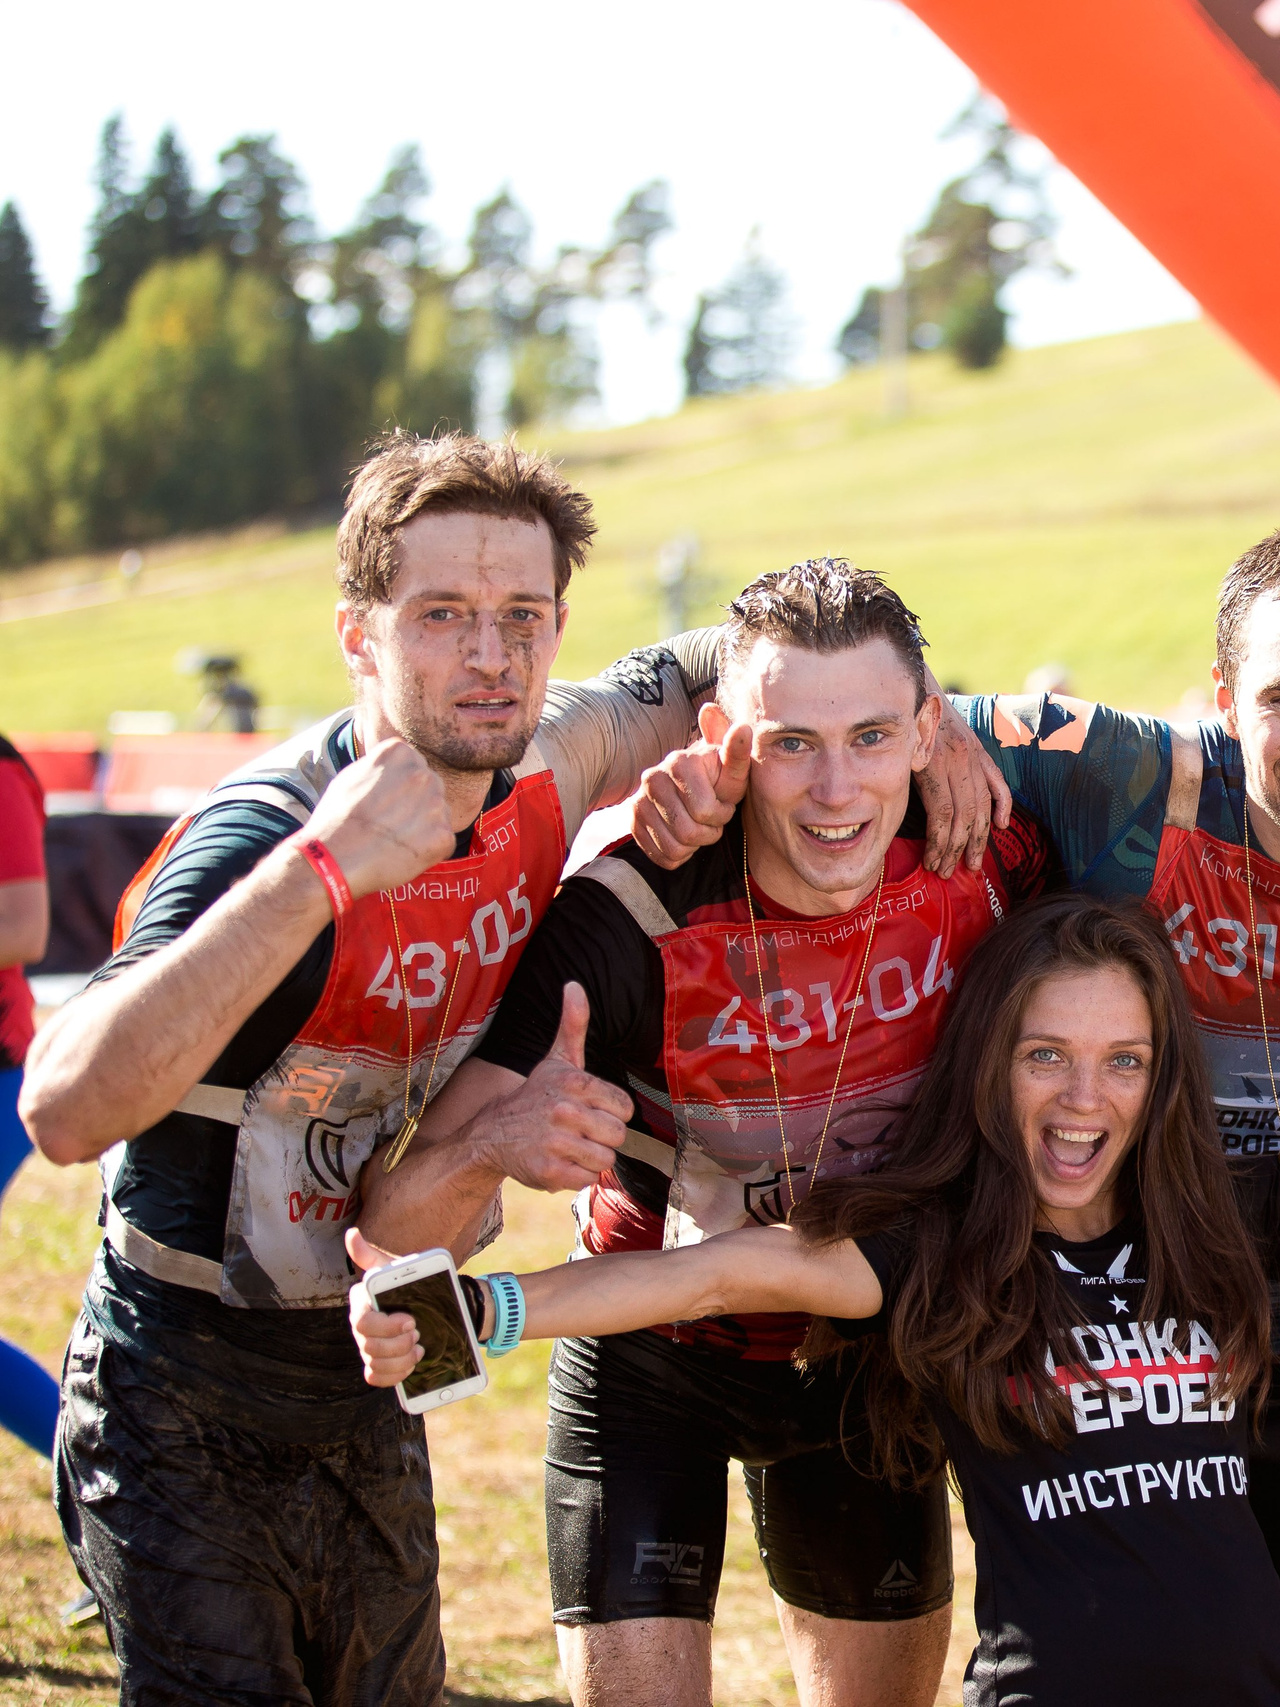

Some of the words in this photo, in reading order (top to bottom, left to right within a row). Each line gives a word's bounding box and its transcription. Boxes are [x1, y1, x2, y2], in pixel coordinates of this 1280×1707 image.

[725, 909, 877, 955] Командный
[708, 935, 955, 1054] 431-04
[1080, 1277, 1106, 1285] ЛИГА
[1108, 1277, 1146, 1285] ГЕРОЕВ
[1035, 1372, 1236, 1438] ЕРОЕВ
[873, 1585, 924, 1598] Reebok
